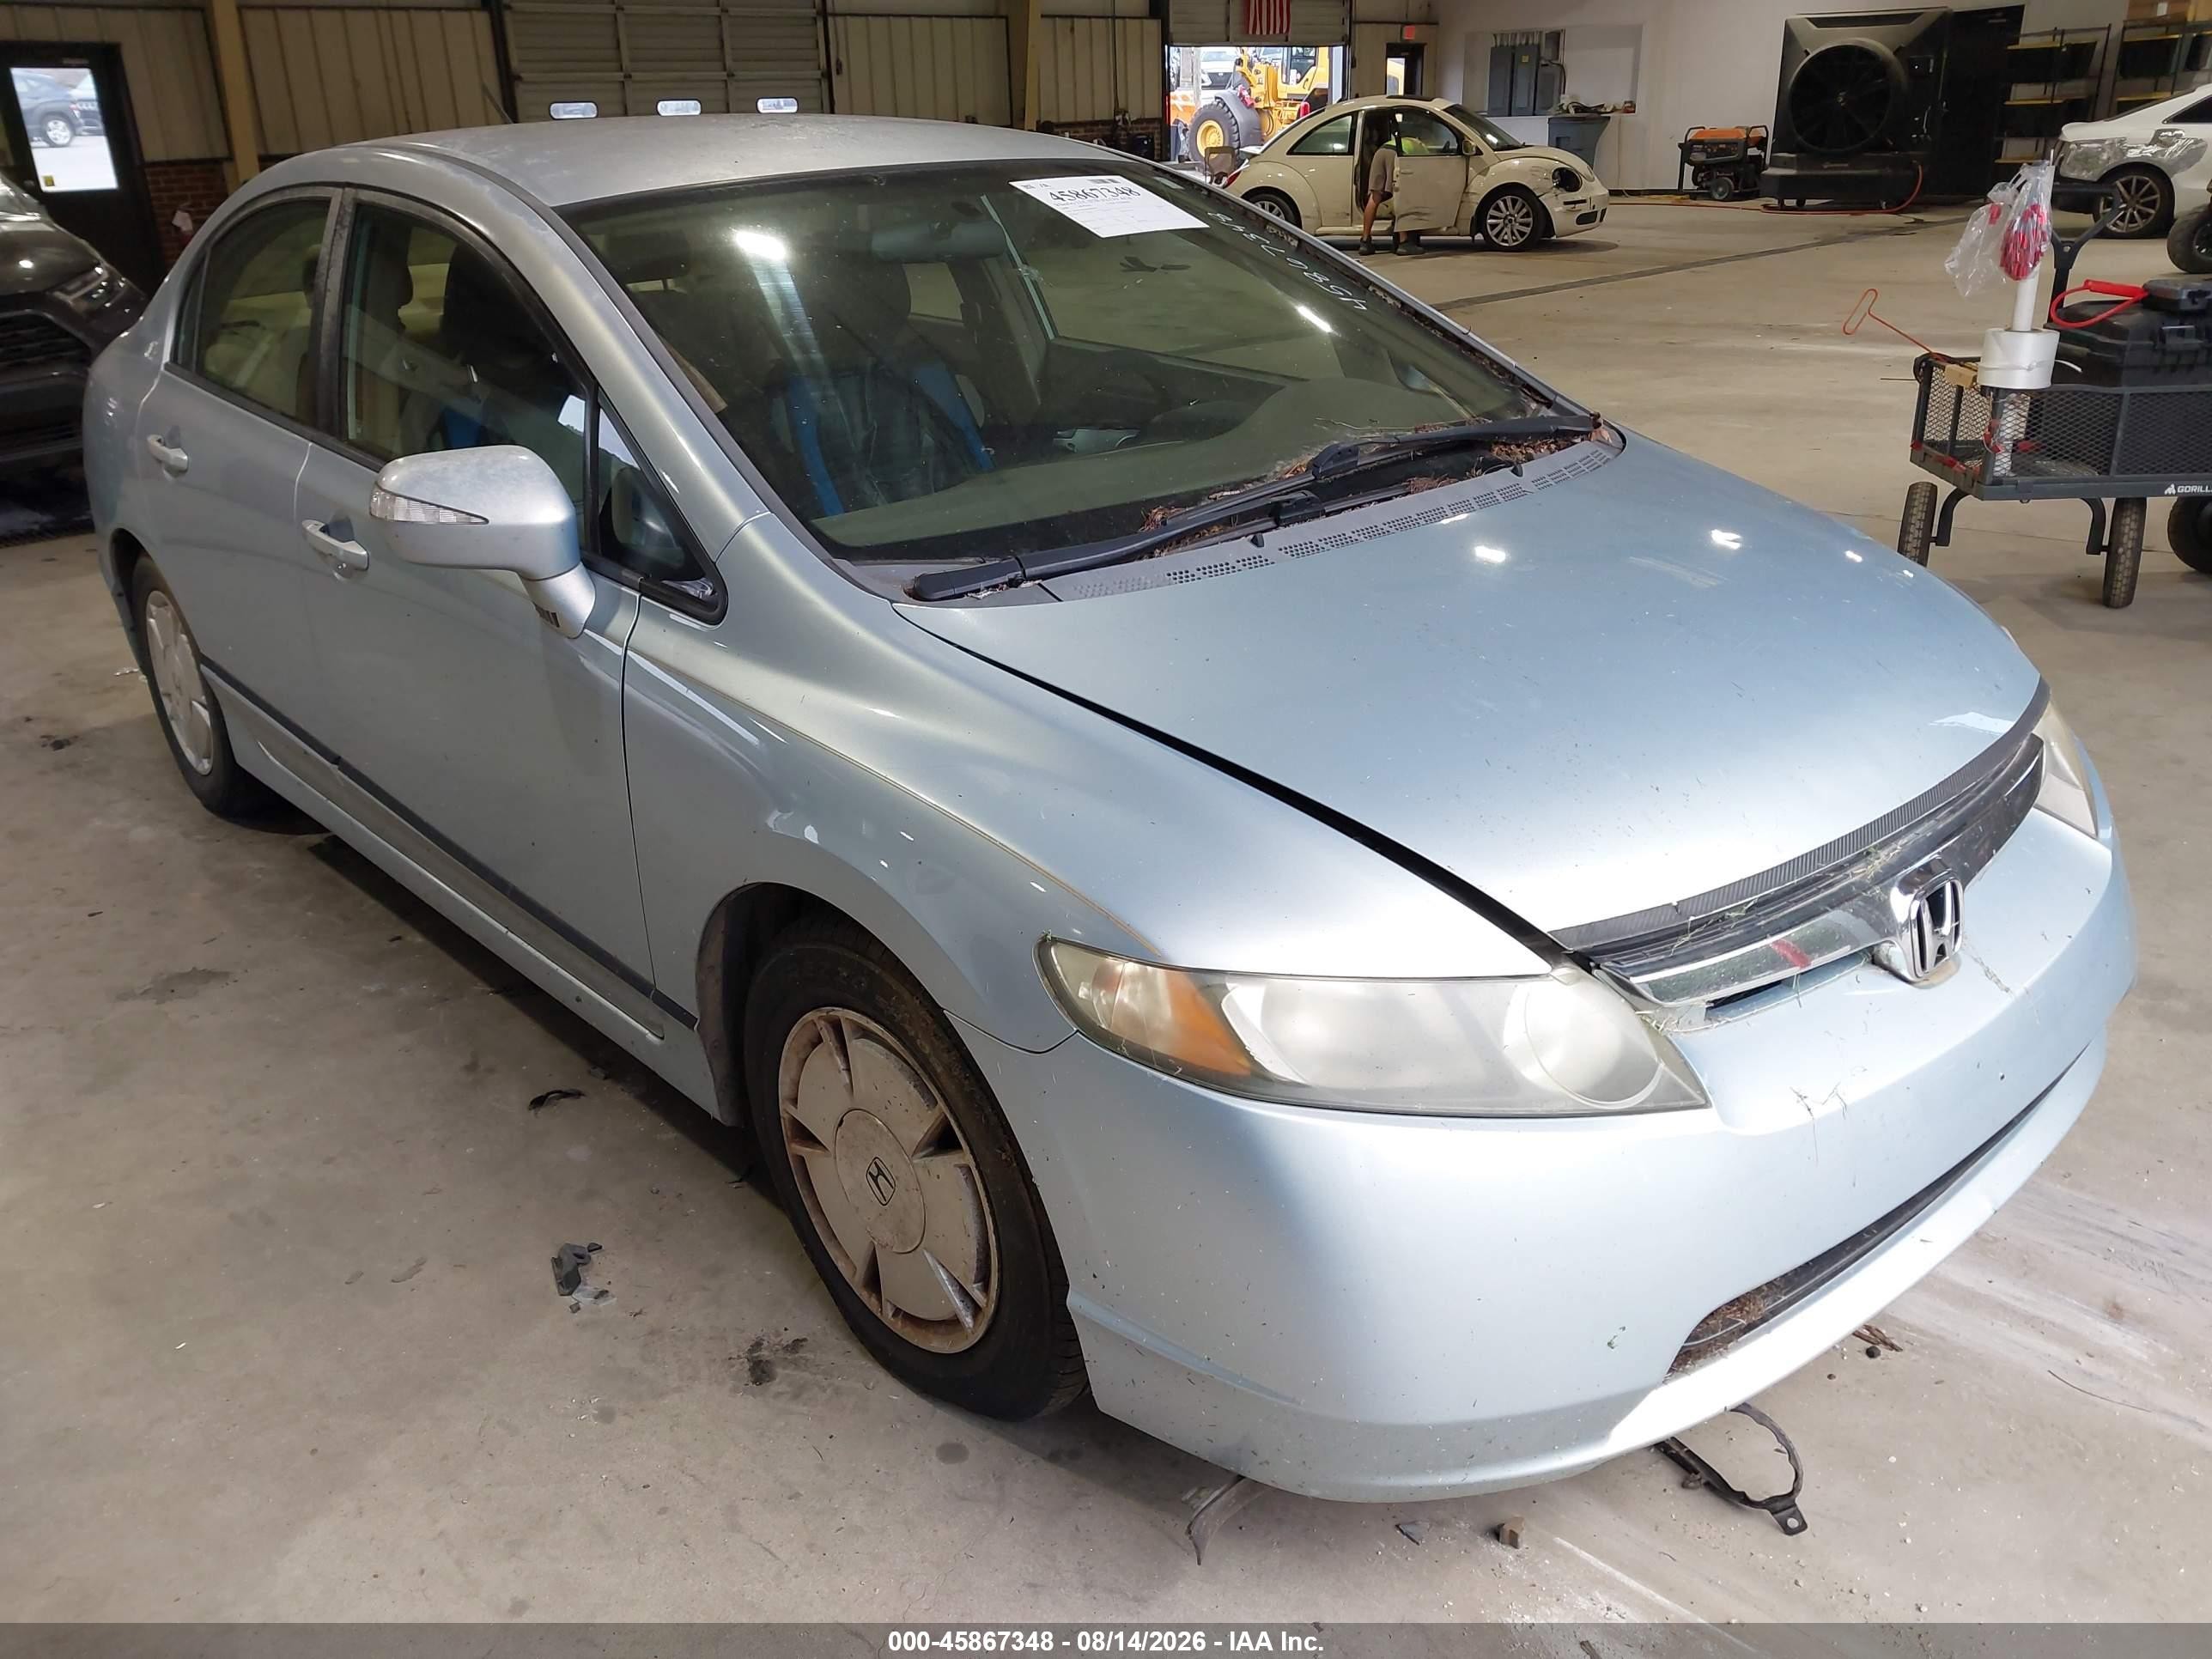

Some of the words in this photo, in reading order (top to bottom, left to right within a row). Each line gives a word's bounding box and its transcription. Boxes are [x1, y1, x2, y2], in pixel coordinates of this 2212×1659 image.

[1048, 186, 1141, 202] 45867348
[1208, 211, 1368, 311] 45867348
[2177, 485, 2212, 494] GORILL
